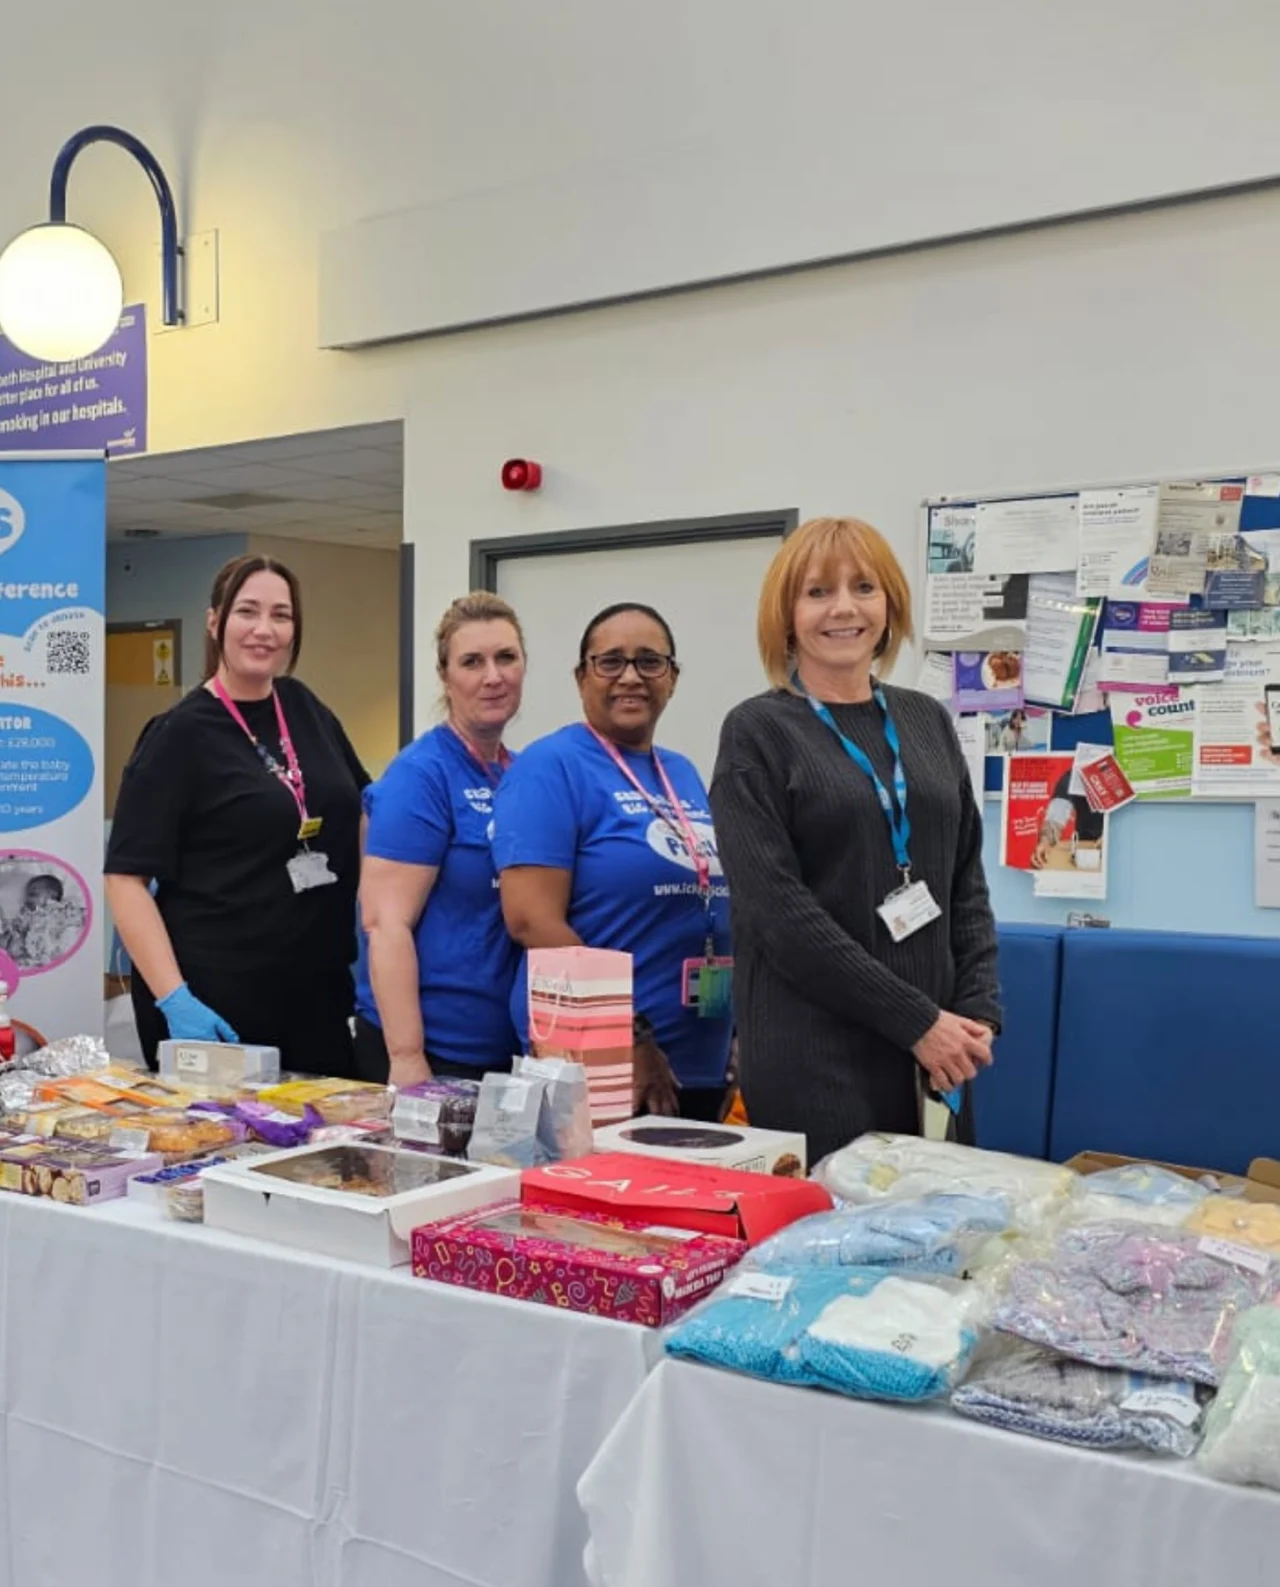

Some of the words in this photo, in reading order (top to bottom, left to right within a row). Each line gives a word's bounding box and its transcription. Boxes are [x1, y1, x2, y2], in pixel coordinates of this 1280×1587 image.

[19, 363, 57, 386] Hospital
[58, 359, 77, 374] and
[77, 350, 128, 373] University
[19, 386, 43, 405] place
[44, 383, 59, 397] for
[60, 378, 71, 395] all
[73, 376, 84, 391] of
[40, 411, 50, 426] in
[52, 408, 70, 423] our
[72, 395, 127, 421] hospitals.
[21, 759, 39, 770] the
[41, 759, 70, 772] baby
[0, 772, 69, 783] temperature
[14, 804, 44, 816] years
